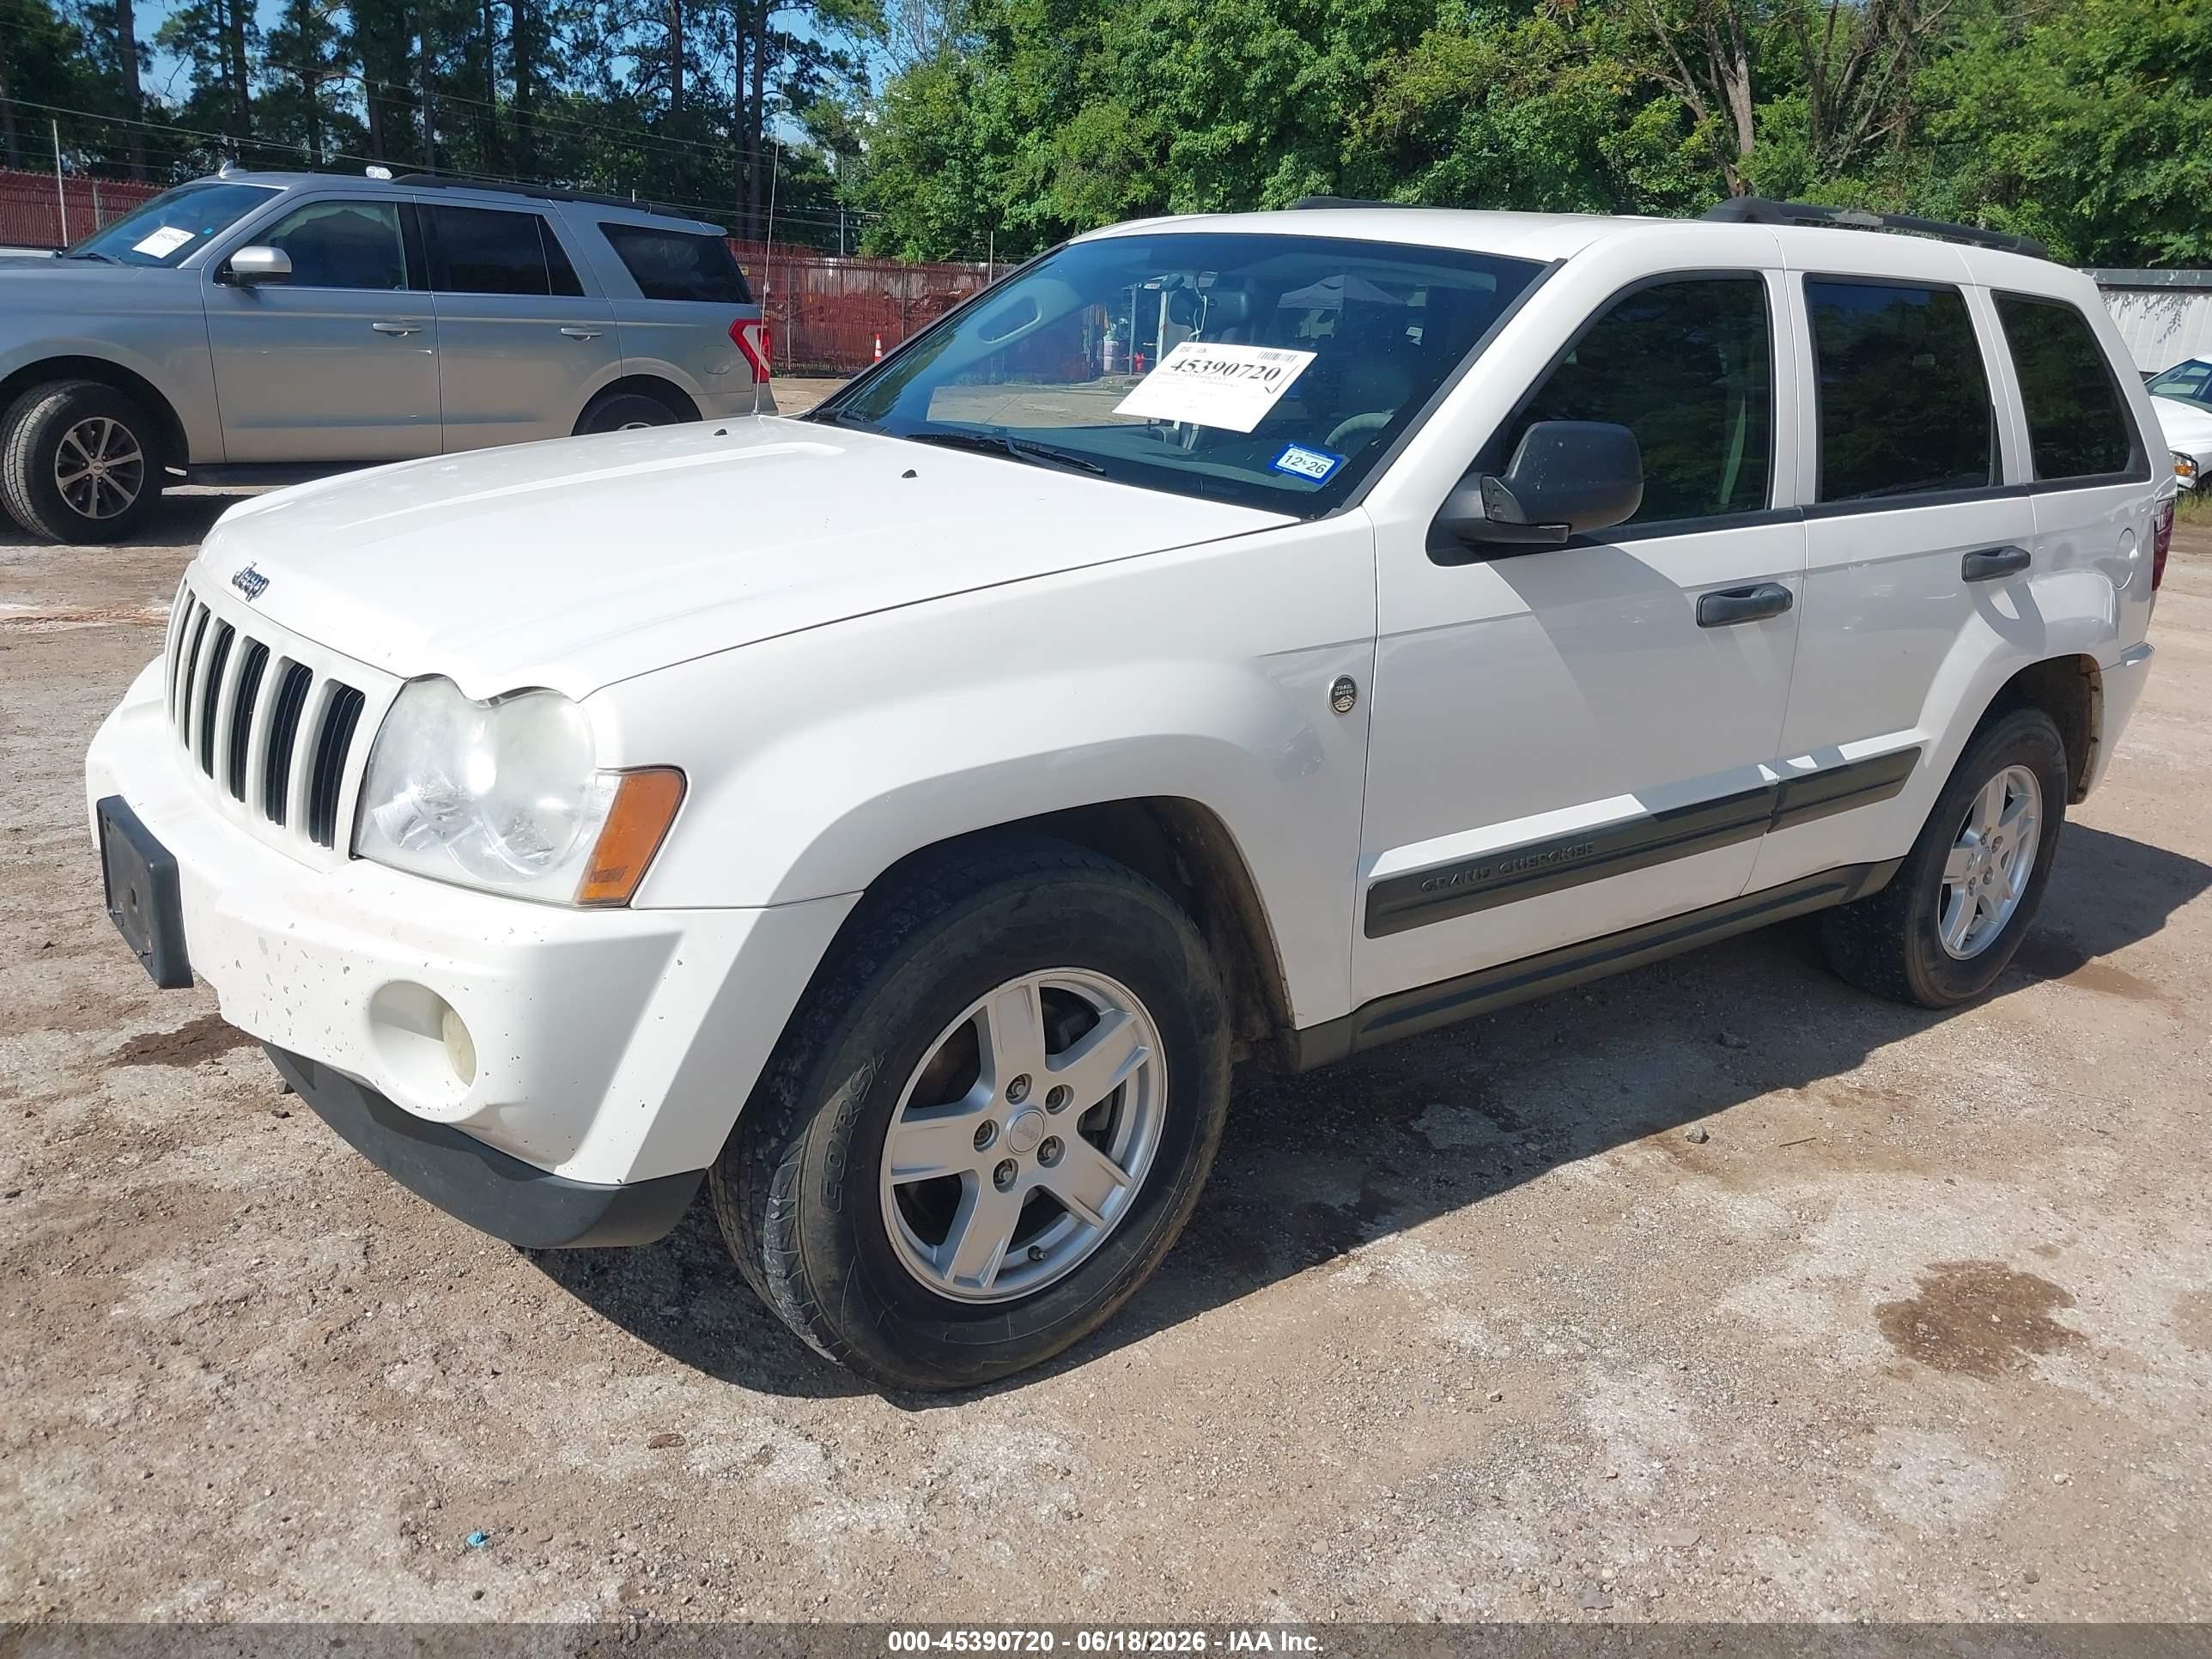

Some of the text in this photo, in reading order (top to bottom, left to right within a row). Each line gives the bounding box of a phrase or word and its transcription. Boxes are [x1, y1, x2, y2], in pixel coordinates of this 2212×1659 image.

[1170, 359, 1281, 381] 45390720
[1285, 454, 1304, 466] 12
[1305, 461, 1328, 474] 26
[231, 563, 270, 603] Jeep
[1420, 842, 1595, 893] GRAND CHEROKEE
